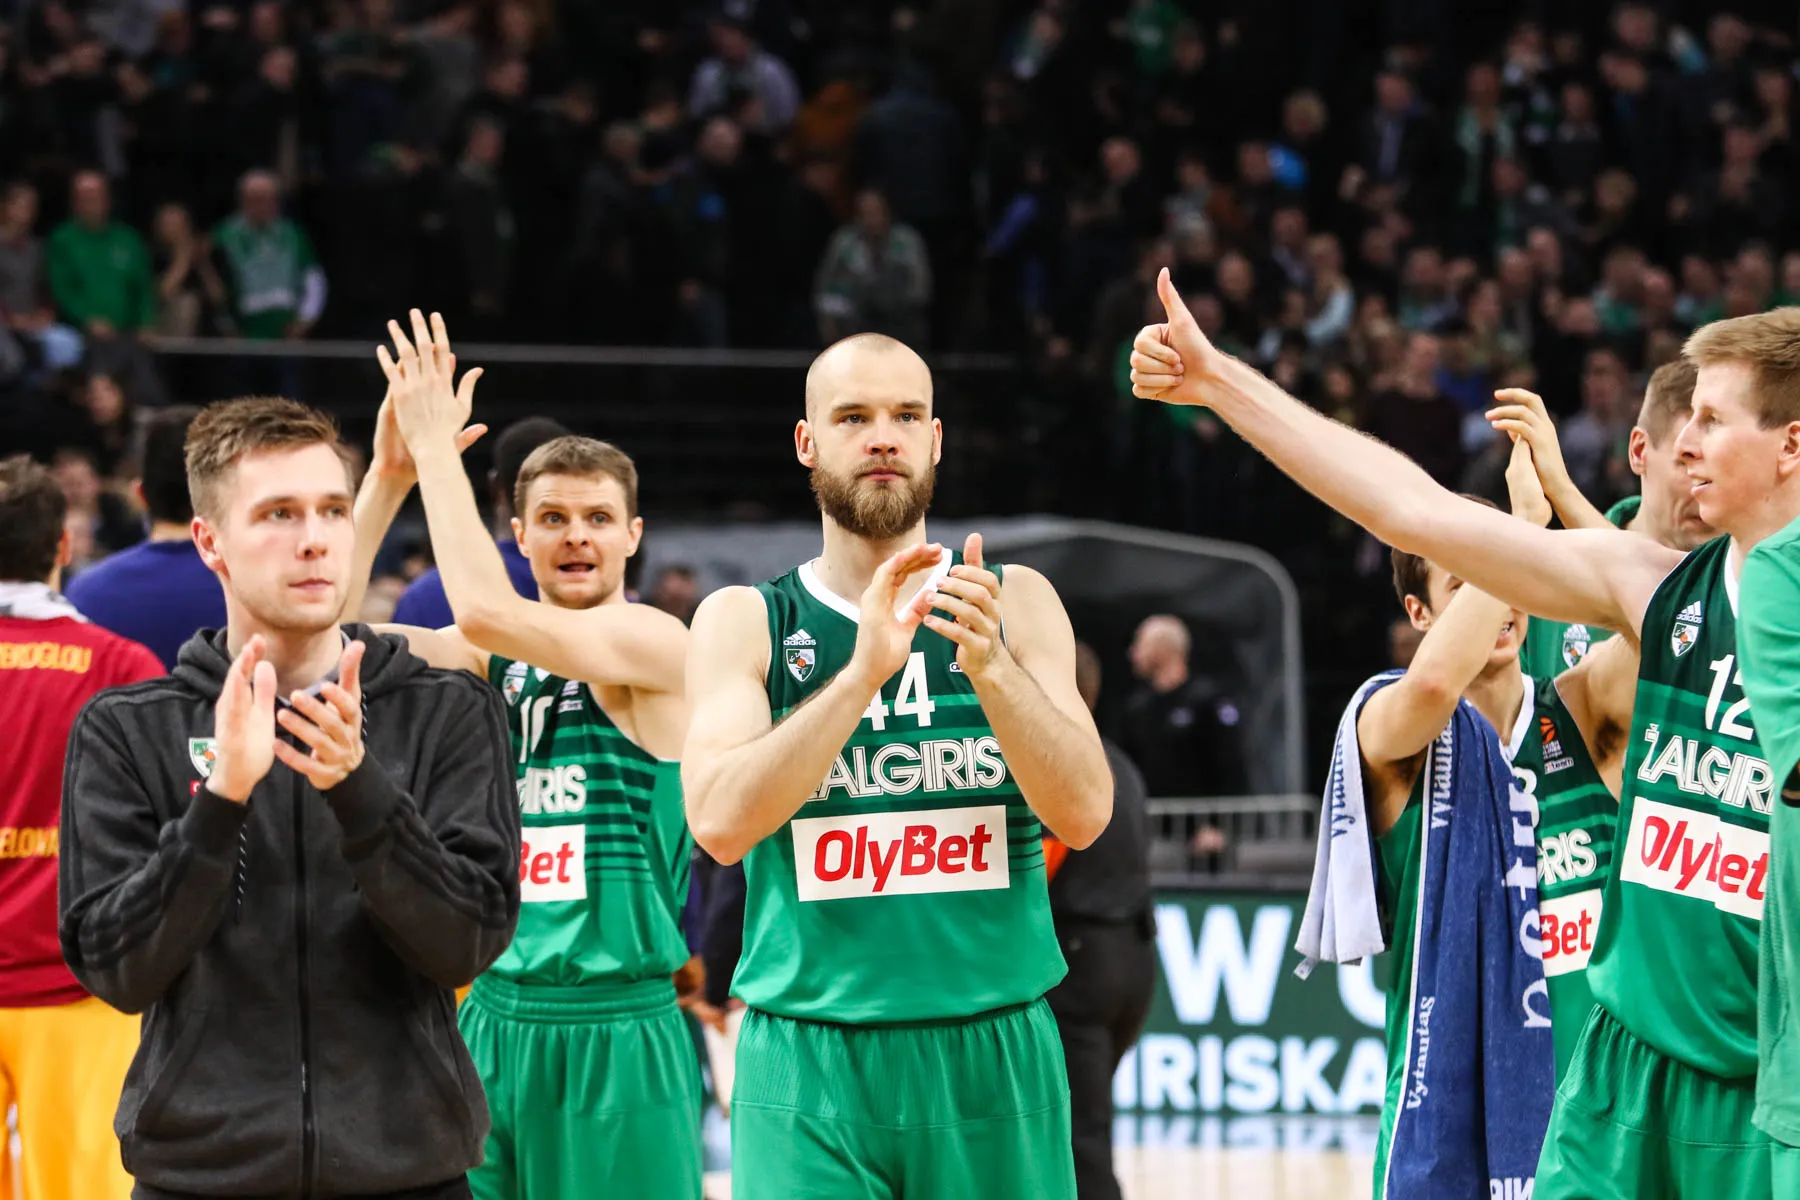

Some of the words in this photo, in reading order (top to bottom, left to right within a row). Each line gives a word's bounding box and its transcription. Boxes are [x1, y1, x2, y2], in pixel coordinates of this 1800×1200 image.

[1705, 654, 1754, 741] 12
[806, 736, 1006, 802] ALGIRIS
[814, 823, 993, 893] OlyBet
[1406, 996, 1435, 1109] Vytautas
